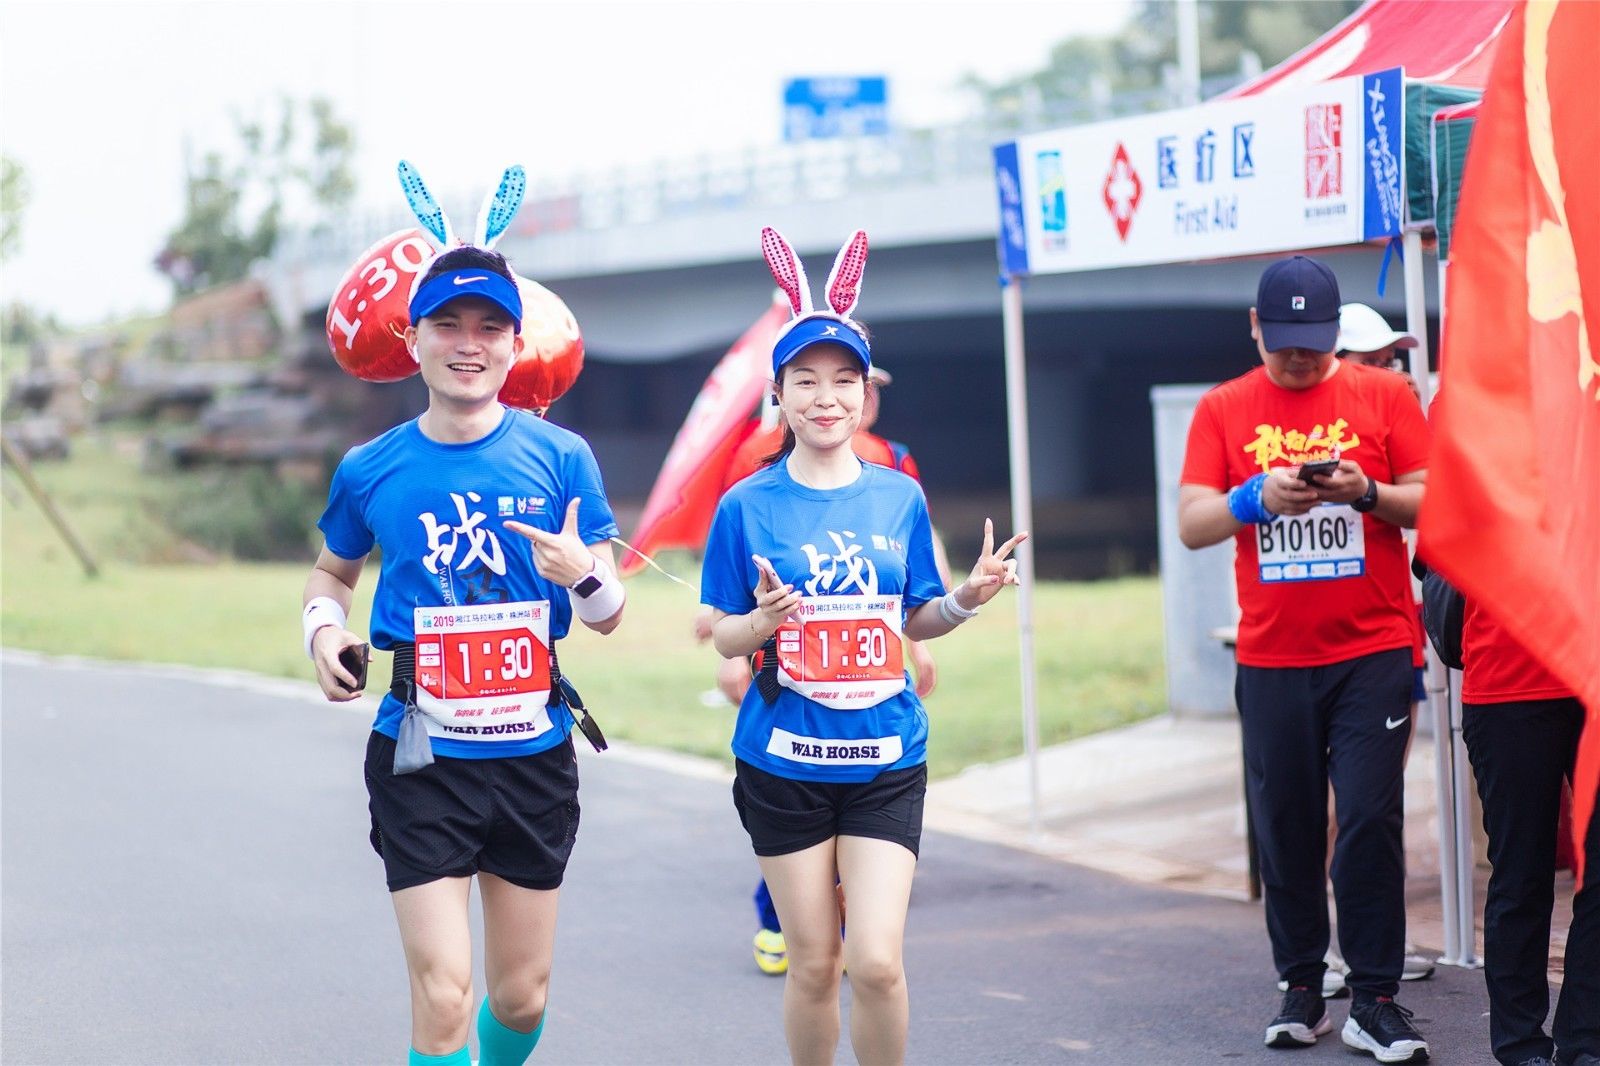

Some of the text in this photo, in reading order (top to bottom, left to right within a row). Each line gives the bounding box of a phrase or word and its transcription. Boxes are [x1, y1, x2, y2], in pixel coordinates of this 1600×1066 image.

[1157, 121, 1255, 189] 医疗区
[1175, 194, 1238, 236] First Aid
[329, 237, 436, 350] 1:30
[418, 491, 506, 576] 战
[1259, 516, 1348, 553] B10160
[800, 530, 878, 597] 战
[458, 636, 534, 684] 1:30
[818, 627, 887, 669] 1:30
[791, 741, 880, 759] WAR HORSE
